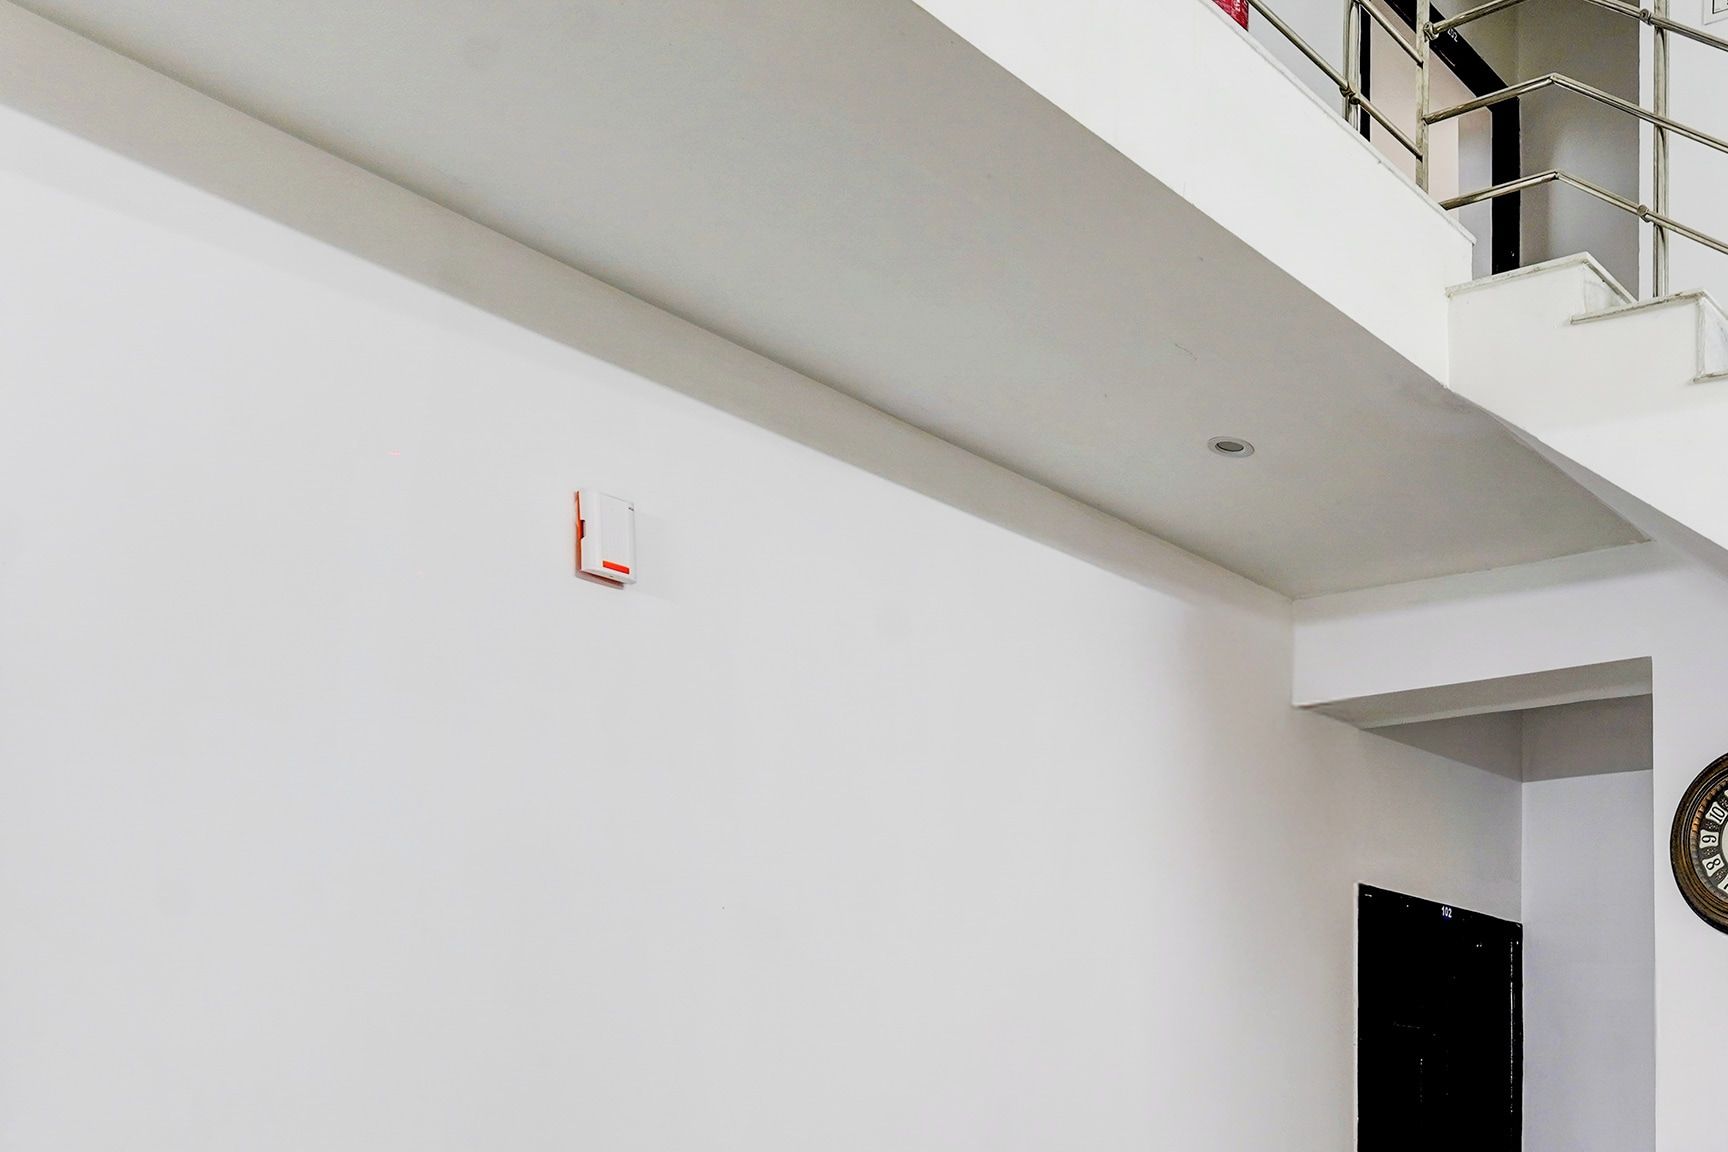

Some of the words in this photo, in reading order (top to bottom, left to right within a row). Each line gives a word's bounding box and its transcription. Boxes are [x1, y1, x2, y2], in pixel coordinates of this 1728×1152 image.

[1709, 806, 1725, 823] 10
[1701, 835, 1717, 843] 9
[1705, 858, 1720, 870] 8
[1441, 905, 1453, 918] 102
